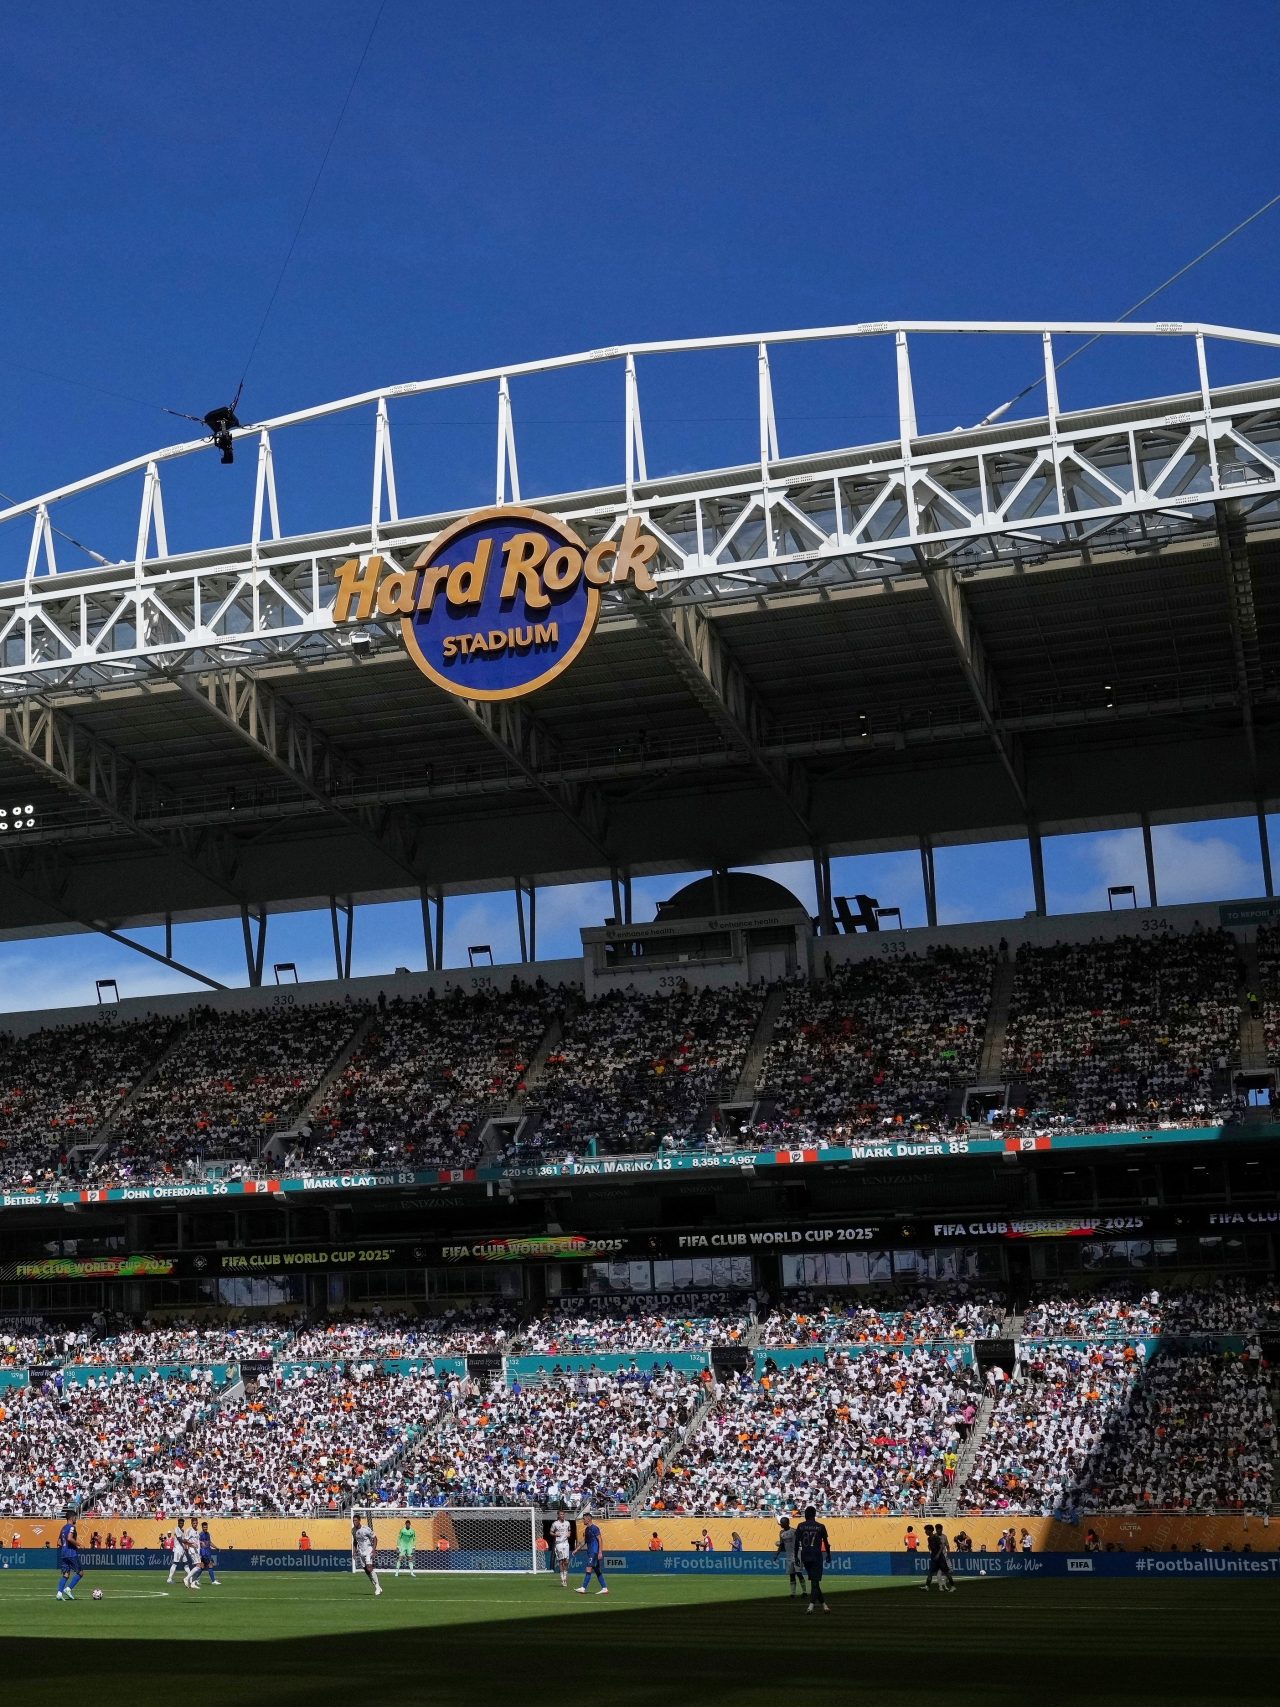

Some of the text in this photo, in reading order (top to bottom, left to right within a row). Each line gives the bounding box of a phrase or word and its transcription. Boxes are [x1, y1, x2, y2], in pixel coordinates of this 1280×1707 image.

[332, 516, 660, 624] Hard Rock
[442, 622, 559, 659] STADIUM
[720, 917, 779, 929] enhance health
[1141, 918, 1168, 932] 334
[617, 927, 674, 938] enhance health
[881, 941, 907, 953] 333
[471, 977, 492, 988] 331
[659, 975, 683, 988] 332
[273, 994, 295, 1006] 330
[98, 1009, 117, 1020] 329
[851, 1142, 969, 1159] MARK DUPER 85
[574, 1155, 757, 1175] DAN MARINO 13 8,358 4,967
[303, 1172, 415, 1190] MARK CLAYTON 83
[121, 1183, 228, 1200] JOHN OFFERDAHL 56
[4, 1194, 42, 1206] BETTERS
[45, 1193, 59, 1204] 75
[1209, 1210, 1280, 1225] FIFA CLU
[933, 1223, 967, 1237] FIFA
[969, 1222, 1008, 1235] CLUB
[678, 1235, 709, 1248] FIFA
[711, 1233, 746, 1246] CLUB
[749, 1230, 801, 1244] WORLD
[804, 1228, 834, 1242] CUP
[441, 1245, 470, 1258] FIFA
[472, 1243, 507, 1256] CLUB
[221, 1255, 248, 1268] FIFA
[250, 1254, 281, 1266] CLUB
[282, 1252, 328, 1265] WORLD
[330, 1251, 356, 1262] CUP
[559, 1297, 585, 1310] FIFA
[589, 1295, 621, 1307] CLUB
[623, 1294, 670, 1307] WORLD
[116, 1554, 145, 1567] UNITES
[663, 1556, 852, 1571] #FootballUnitesTorld
[966, 1558, 1001, 1571] UNITES
[1070, 1561, 1090, 1569] FIFA
[1135, 1557, 1280, 1572] #FootballUnitesT
